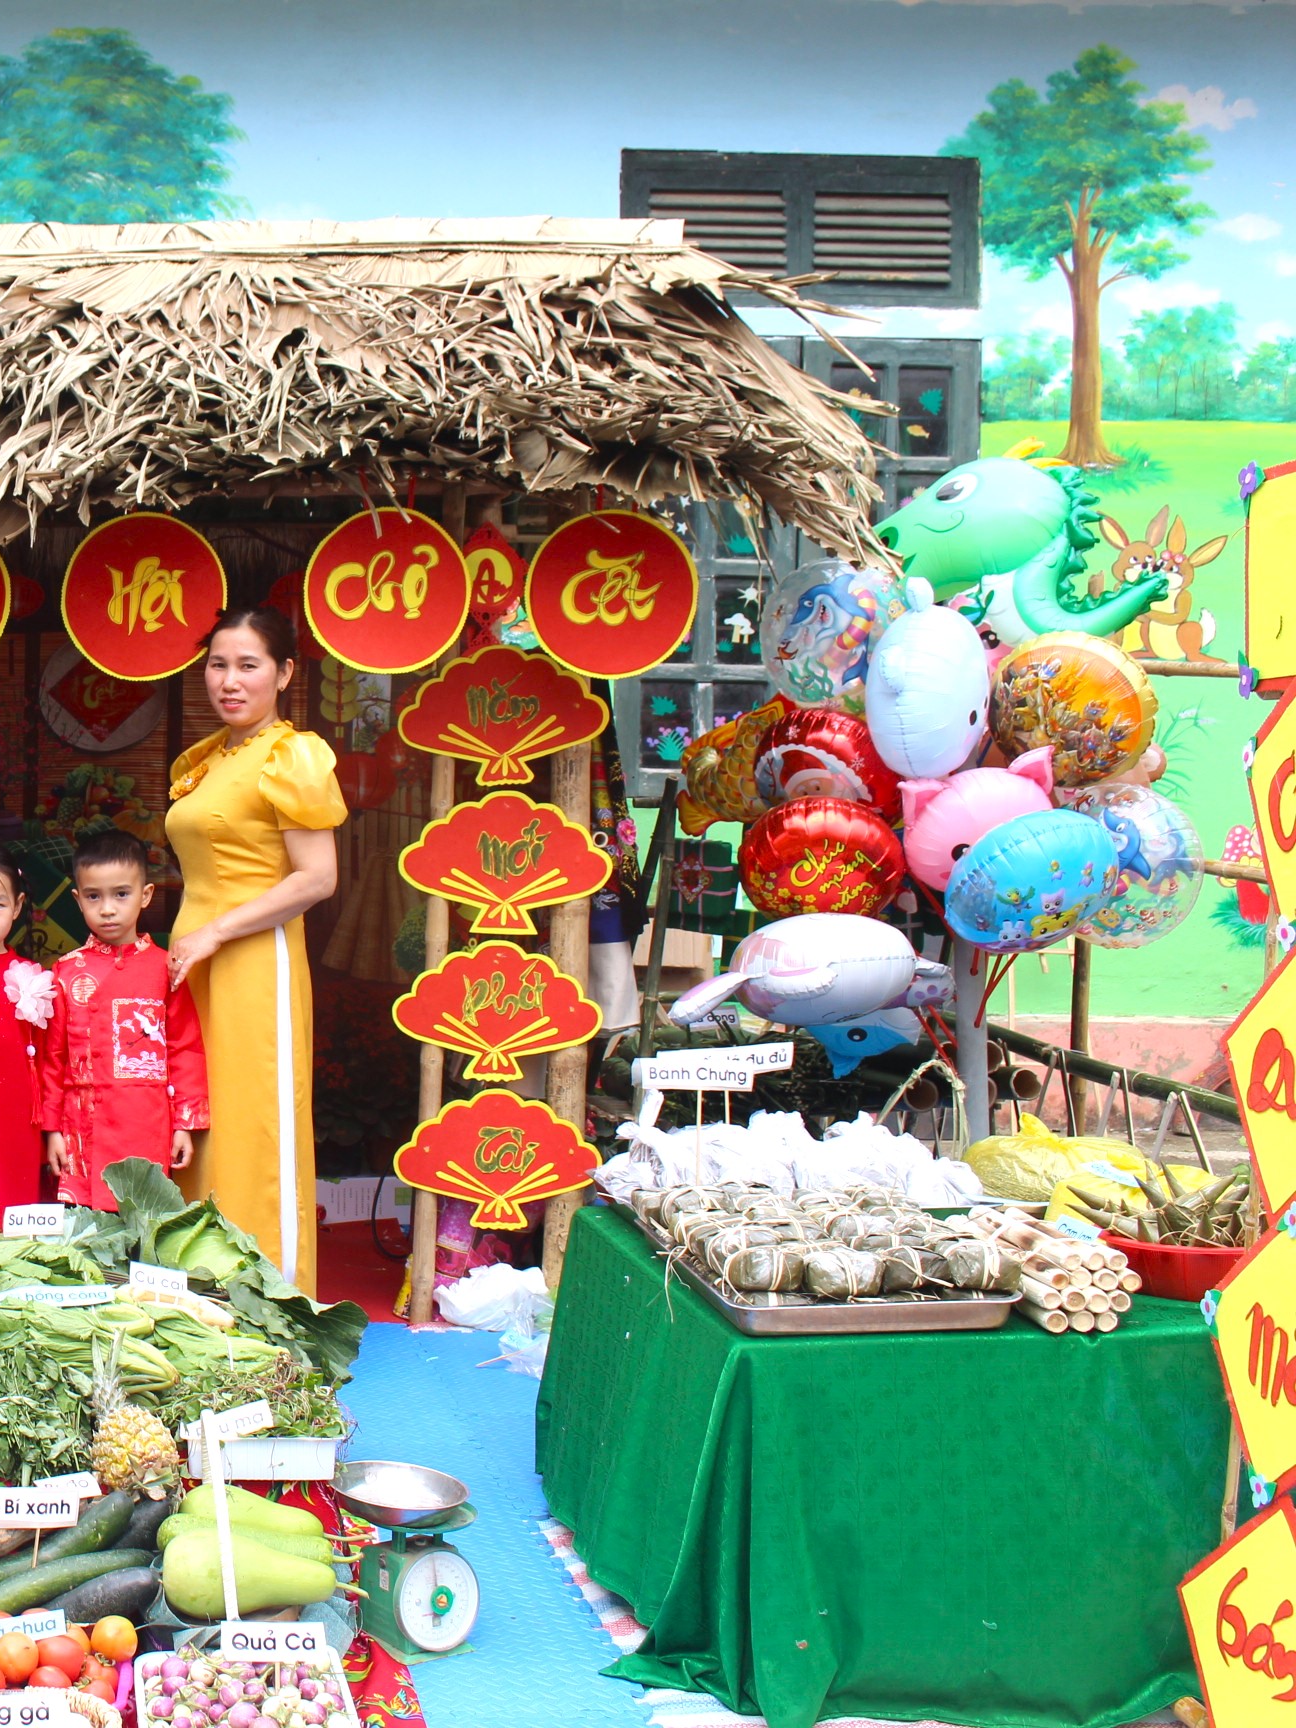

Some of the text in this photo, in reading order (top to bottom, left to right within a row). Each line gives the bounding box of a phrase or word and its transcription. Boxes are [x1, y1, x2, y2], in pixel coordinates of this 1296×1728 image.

[324, 544, 440, 621] Chợ
[8, 1214, 23, 1226] Su
[4, 1498, 71, 1515] Bí xanh
[231, 1630, 316, 1651] Quả Cà
[20, 1702, 50, 1725] gà
